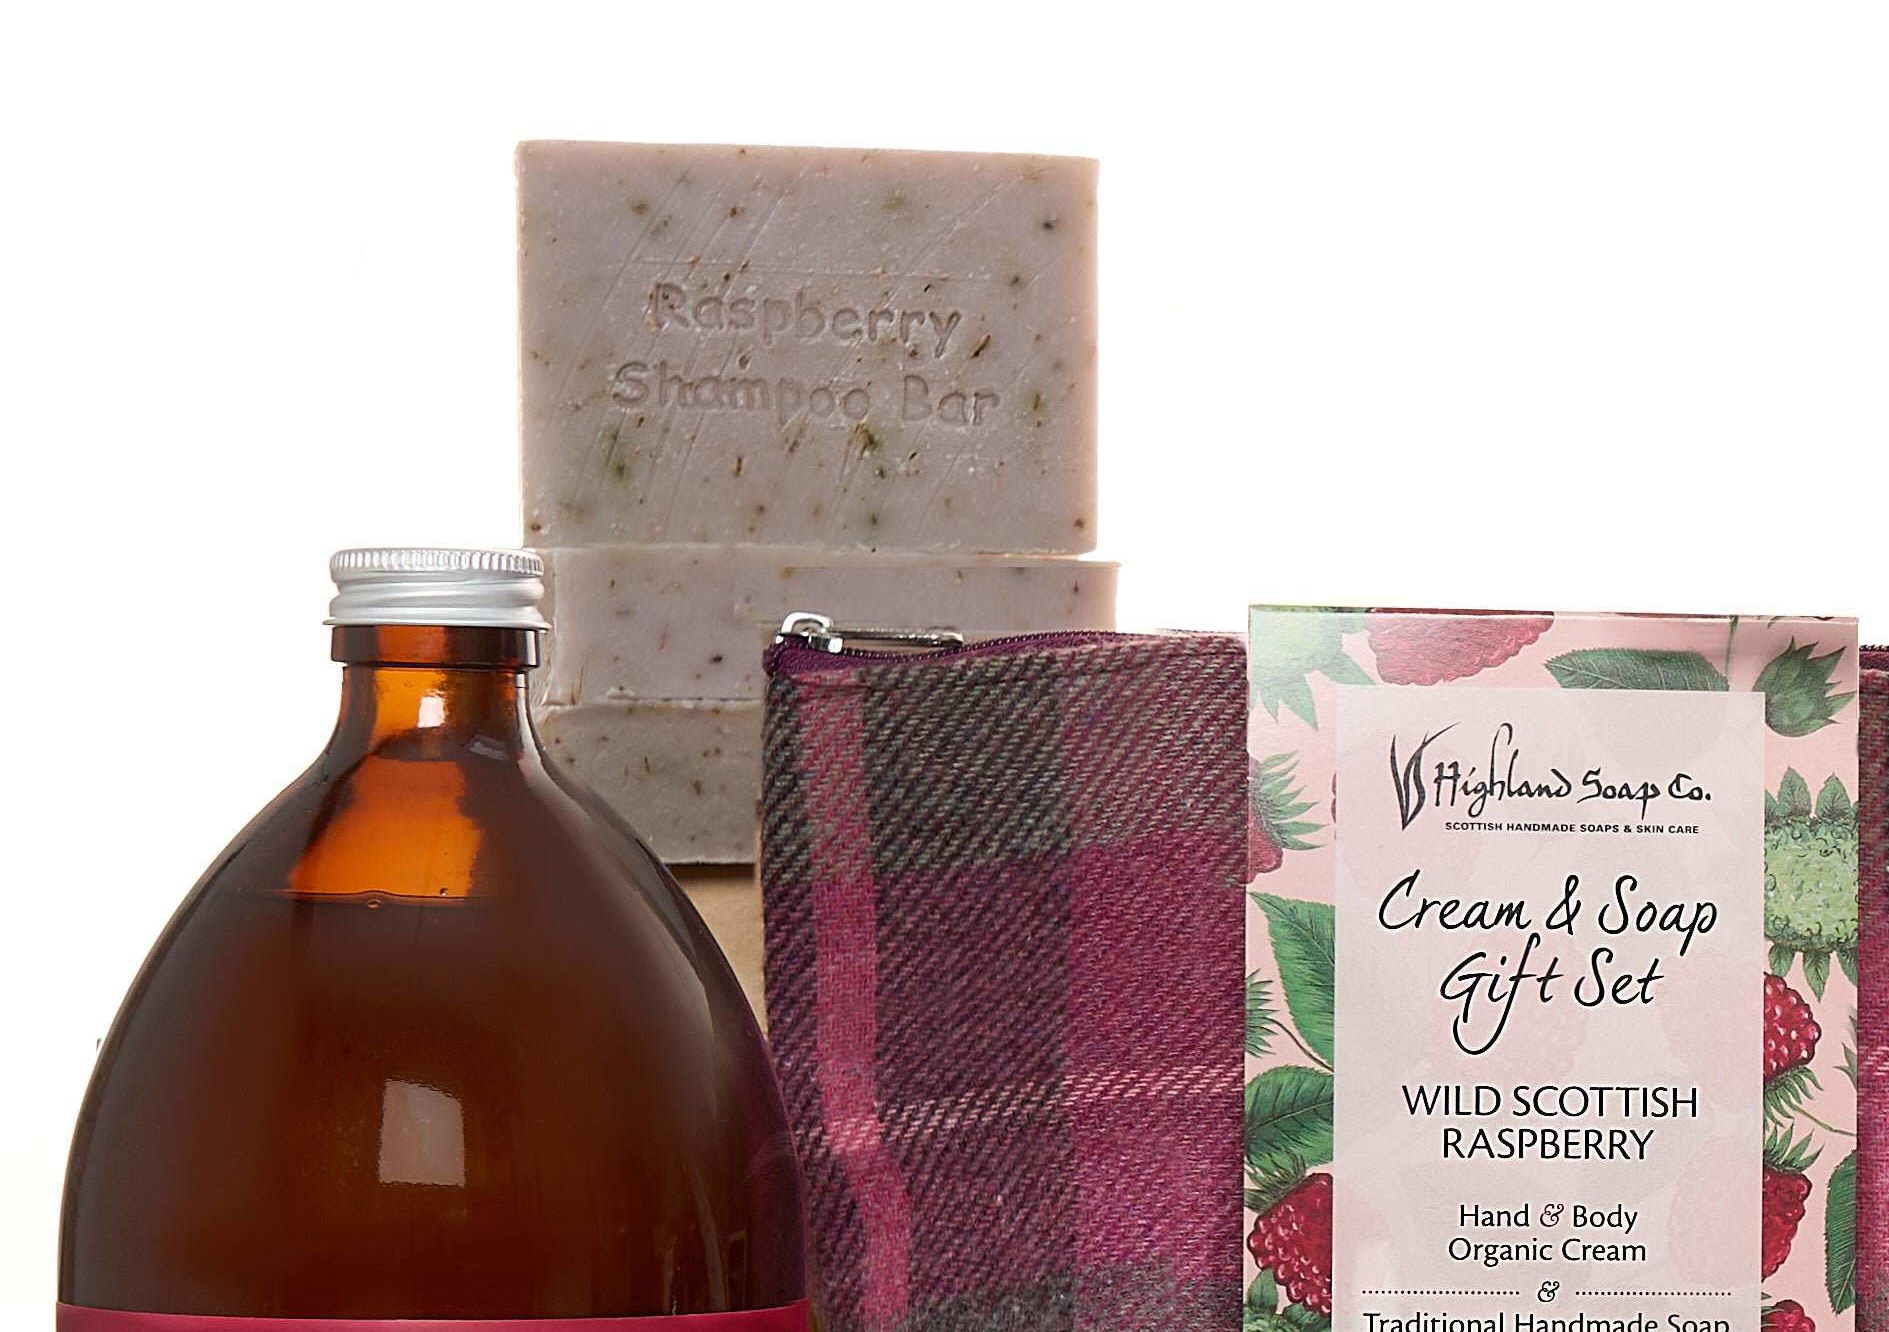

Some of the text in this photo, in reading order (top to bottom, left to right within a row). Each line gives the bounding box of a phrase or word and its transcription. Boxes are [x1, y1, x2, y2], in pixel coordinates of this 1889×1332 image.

[647, 280, 963, 359] Raspberry
[611, 361, 1002, 428] Shampoo Bar
[1433, 722, 1712, 821] Highland Soap Co.
[1378, 868, 1718, 957] Cream & Soap
[1439, 932, 1665, 1056] Gift Set
[1401, 1085, 1697, 1118] WILD SCOTTISH
[1443, 1127, 1655, 1160] RASPBERRY
[1448, 1237, 1646, 1268] Organic Cream
[1460, 1203, 1638, 1235] Hand & Body
